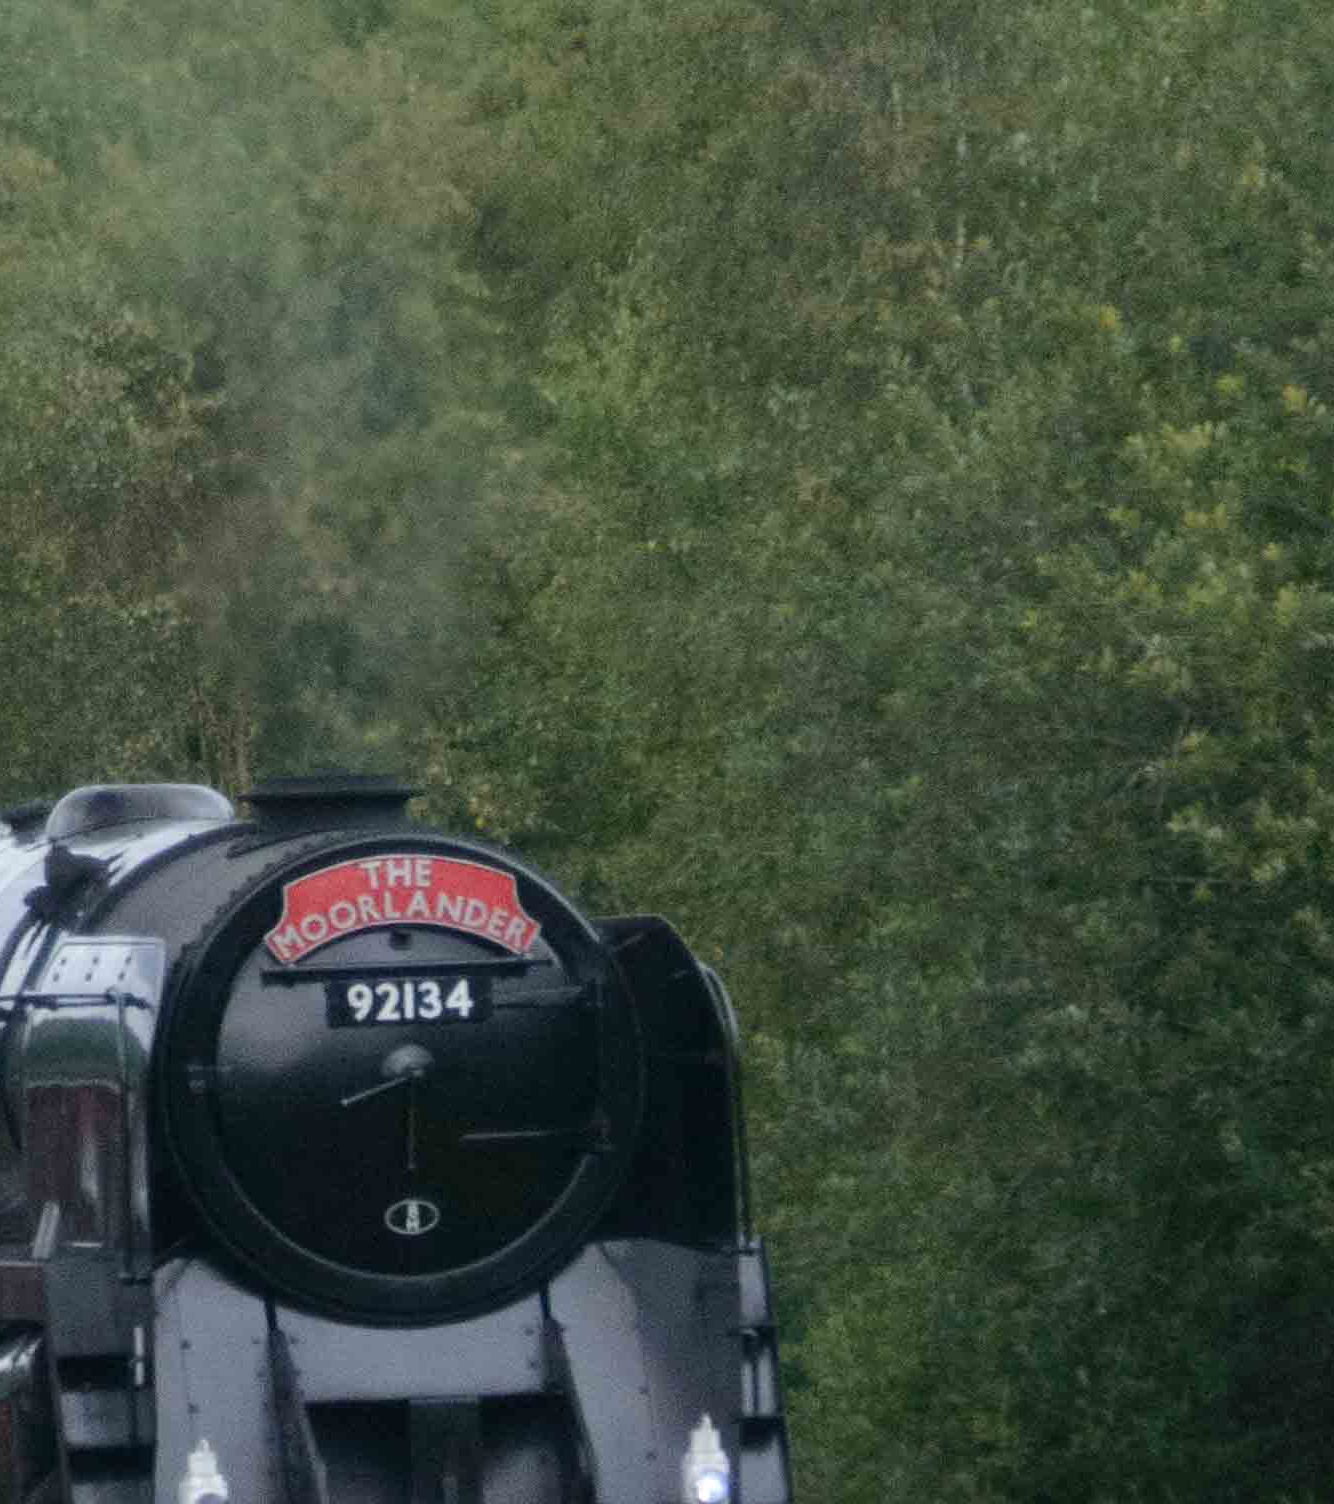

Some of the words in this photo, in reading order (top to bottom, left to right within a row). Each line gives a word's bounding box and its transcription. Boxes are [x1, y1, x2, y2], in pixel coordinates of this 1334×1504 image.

[359, 858, 433, 889] THE
[271, 890, 527, 957] MOORLANDER
[346, 978, 474, 1021] 92134
